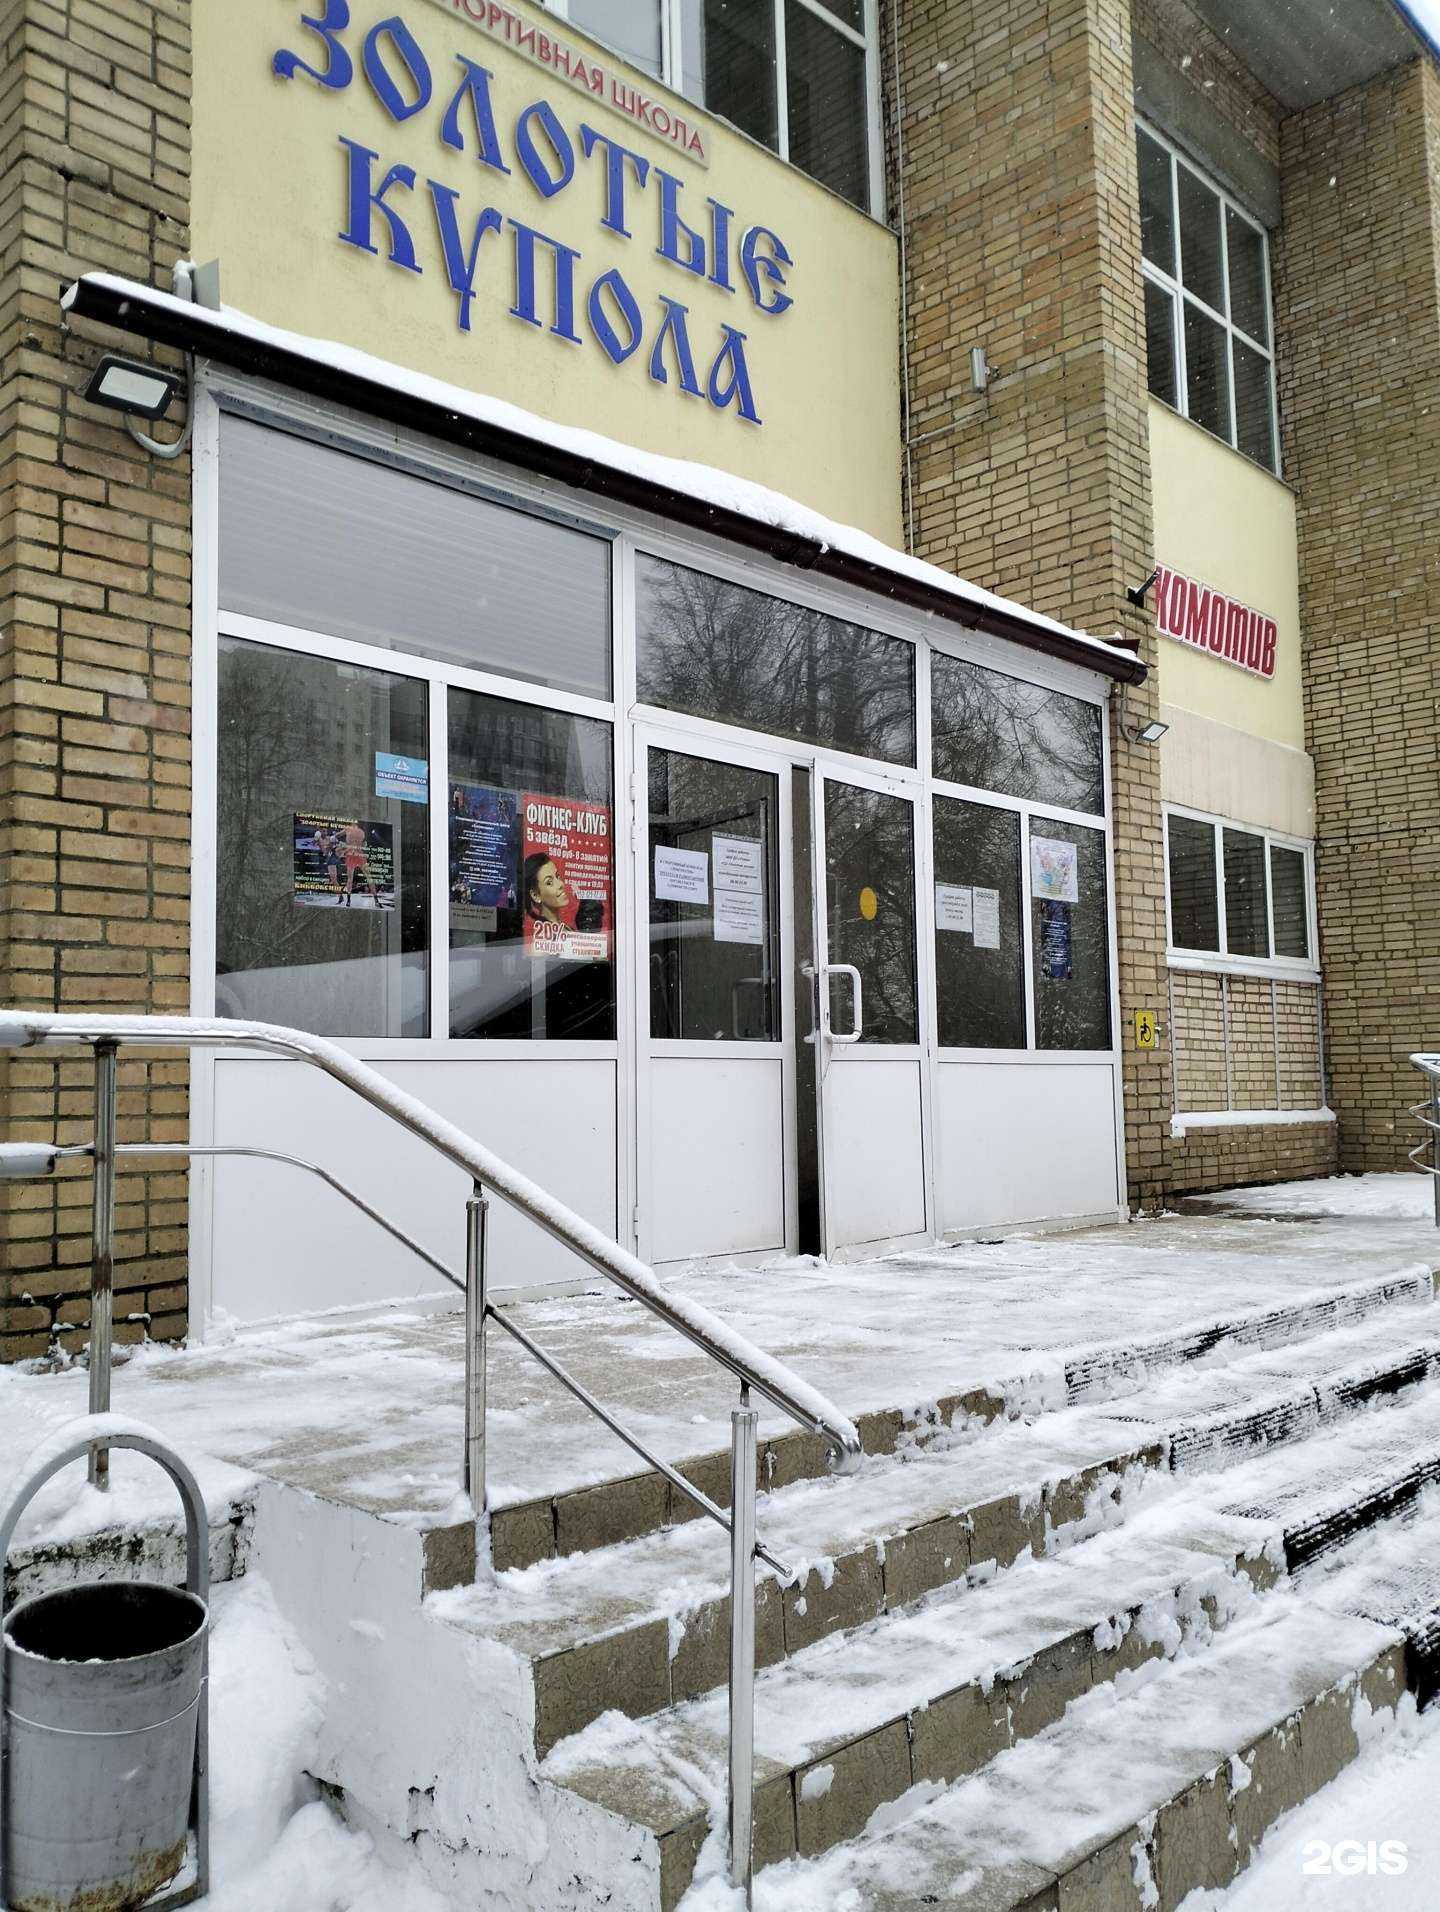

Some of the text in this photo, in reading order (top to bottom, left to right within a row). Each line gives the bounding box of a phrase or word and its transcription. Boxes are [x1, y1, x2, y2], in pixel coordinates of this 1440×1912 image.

[610, 79, 705, 158] ШКОЛА
[272, 0, 794, 315] ЗОЛОТЫЕ
[338, 134, 763, 427] КУПОЛА
[526, 802, 608, 837] ФИТНЕС-КЛУБ
[526, 827, 534, 842] 5
[535, 831, 568, 849] звёзд
[535, 921, 567, 942] 20%
[535, 941, 565, 953] СКИДКА
